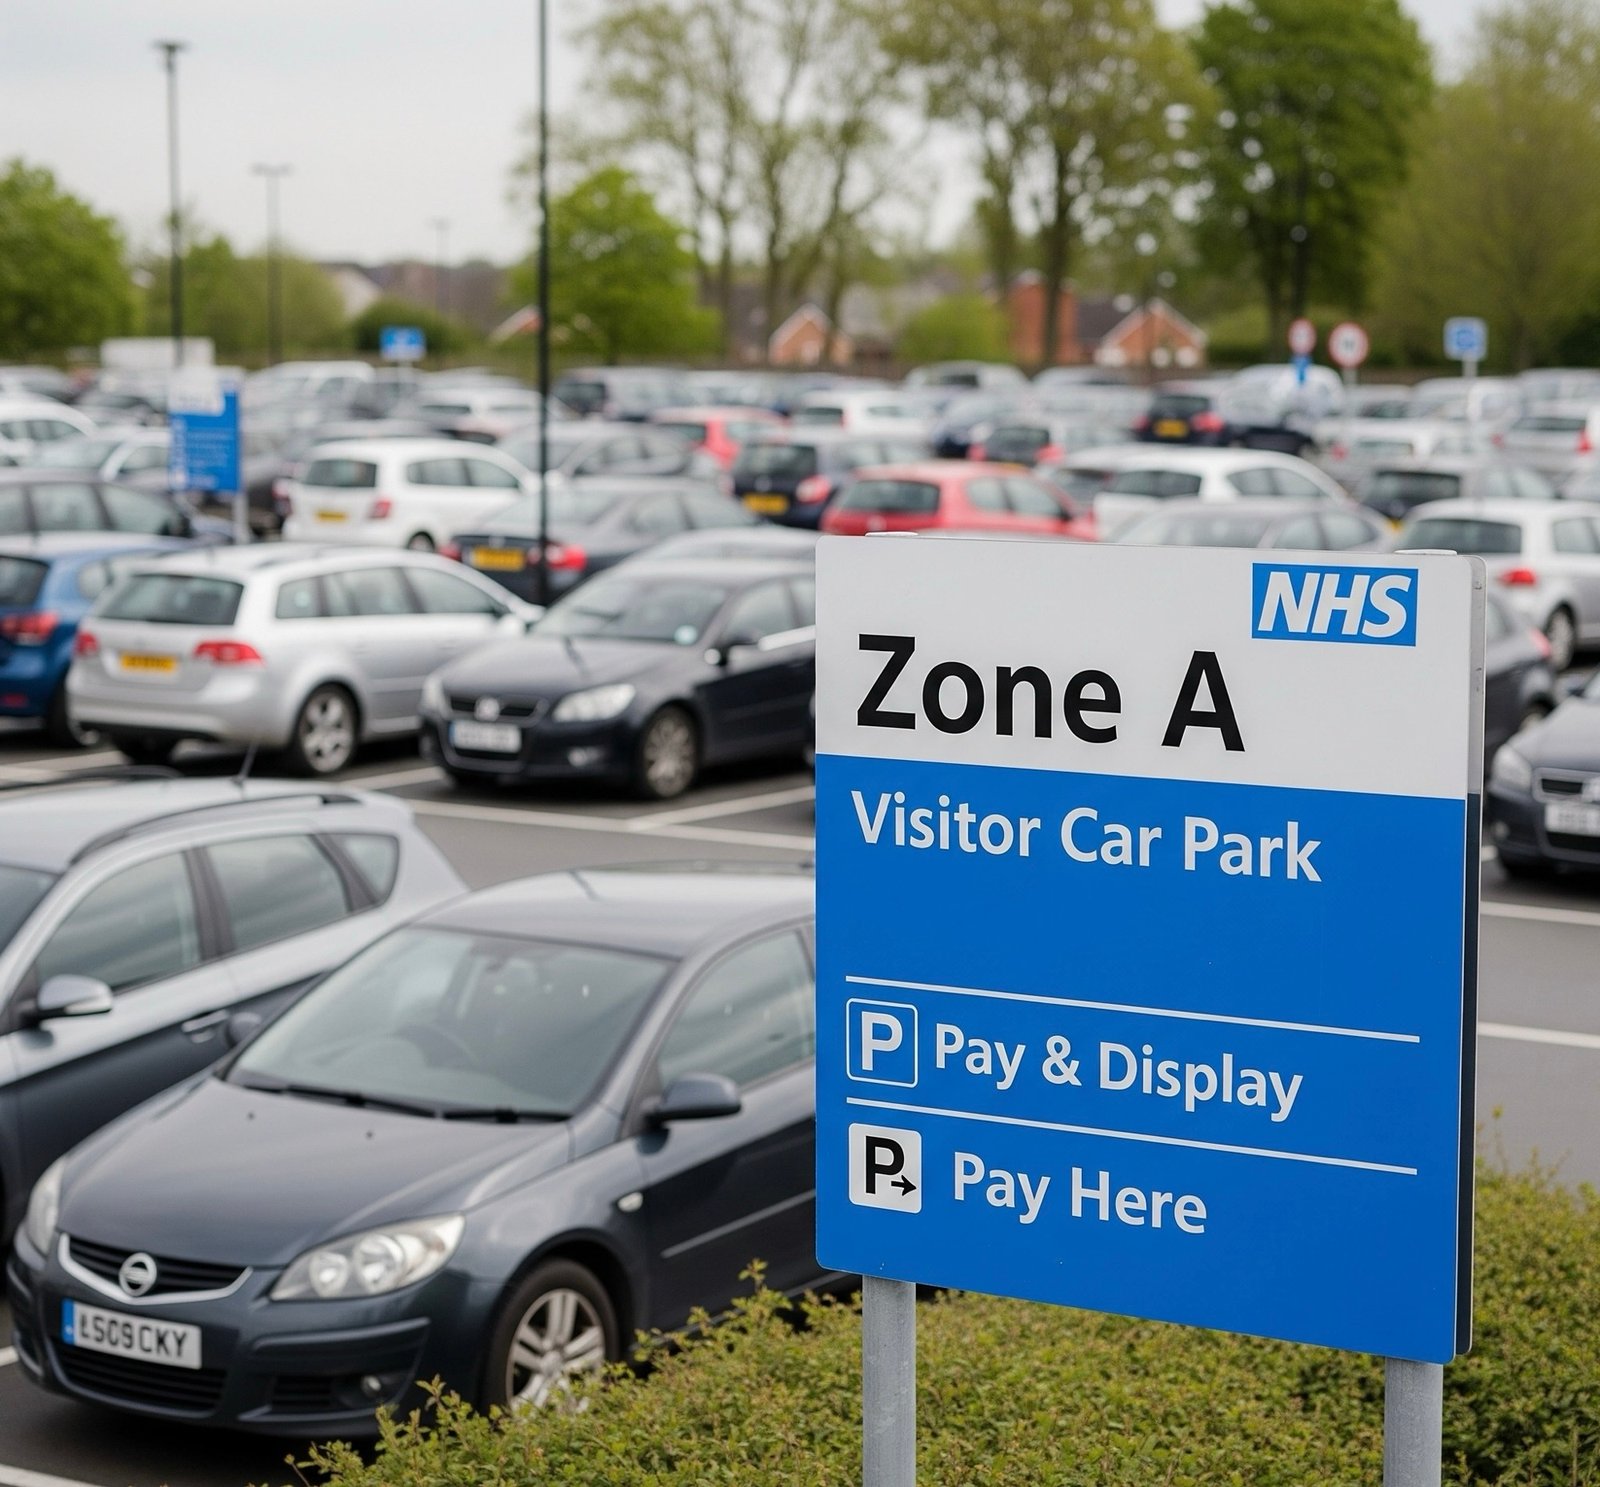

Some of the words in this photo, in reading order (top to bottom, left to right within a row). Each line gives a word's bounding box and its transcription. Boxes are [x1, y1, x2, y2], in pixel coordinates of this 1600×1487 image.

[1258, 571, 1412, 638] NHS
[857, 634, 1122, 744] Zone
[1160, 650, 1246, 752] A
[851, 790, 1041, 857] Visitor
[1060, 807, 1162, 867] Car
[1184, 816, 1322, 882] Park
[861, 1011, 903, 1071] P
[936, 1023, 1026, 1090] Pay
[1042, 1035, 1082, 1086] &
[1099, 1041, 1304, 1122] Display
[953, 1151, 1051, 1224] Pay
[1071, 1167, 1207, 1234] Here
